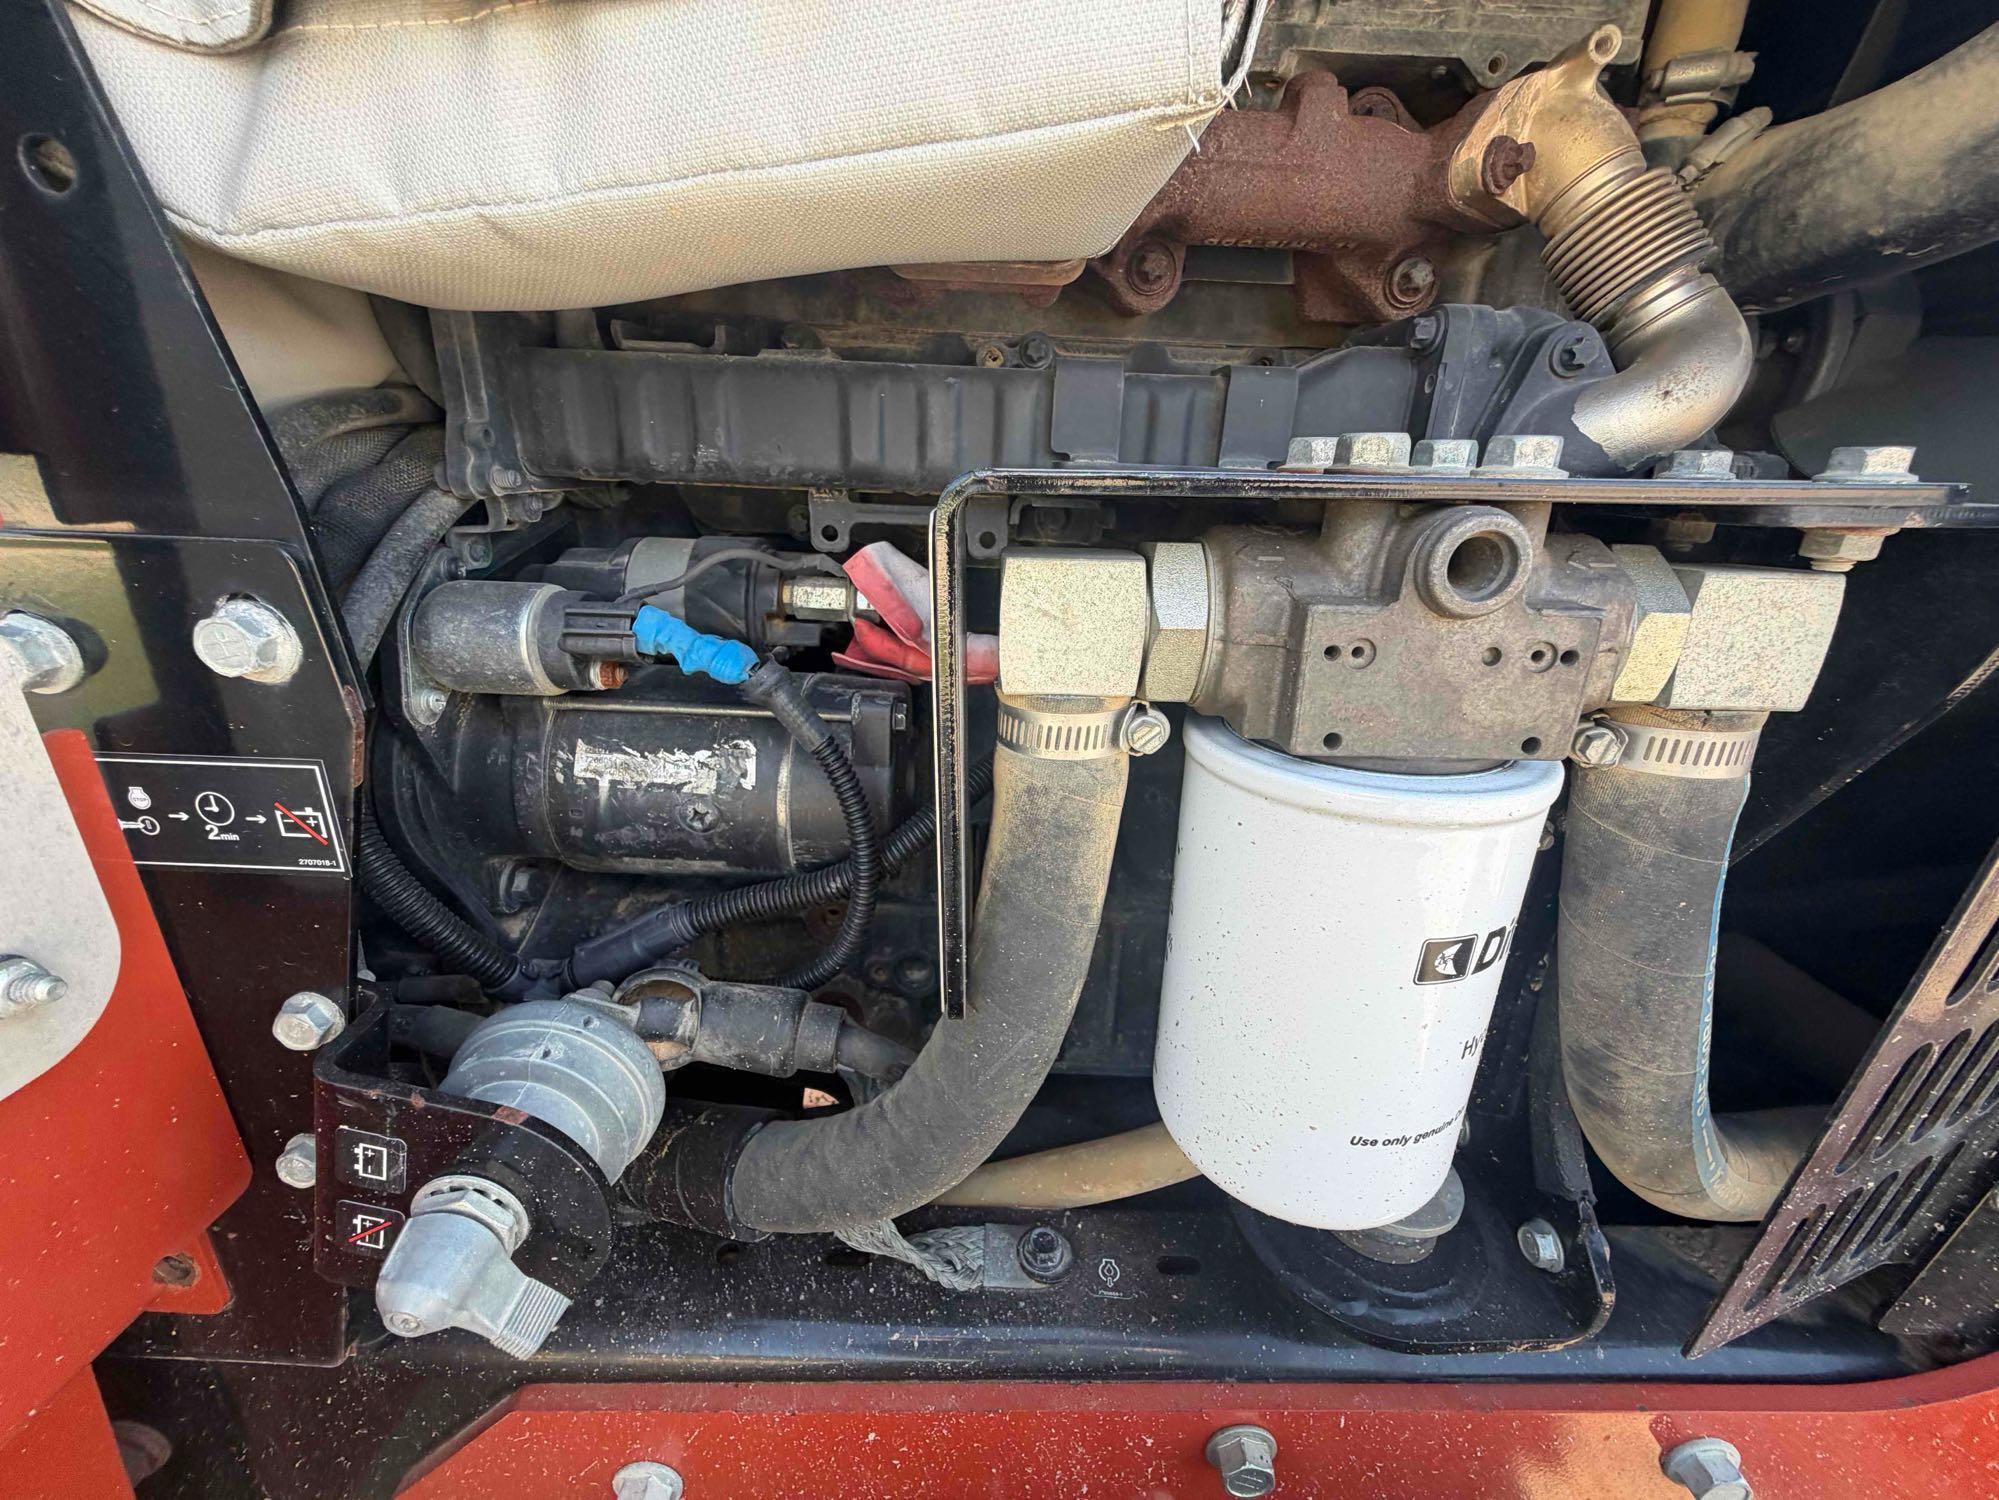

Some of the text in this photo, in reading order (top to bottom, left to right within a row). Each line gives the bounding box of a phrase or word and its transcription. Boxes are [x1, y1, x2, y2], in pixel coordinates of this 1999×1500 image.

[298, 857, 337, 867] 2707018-1
[1349, 1135, 1379, 1147] Use
[1381, 1134, 1413, 1147] only
